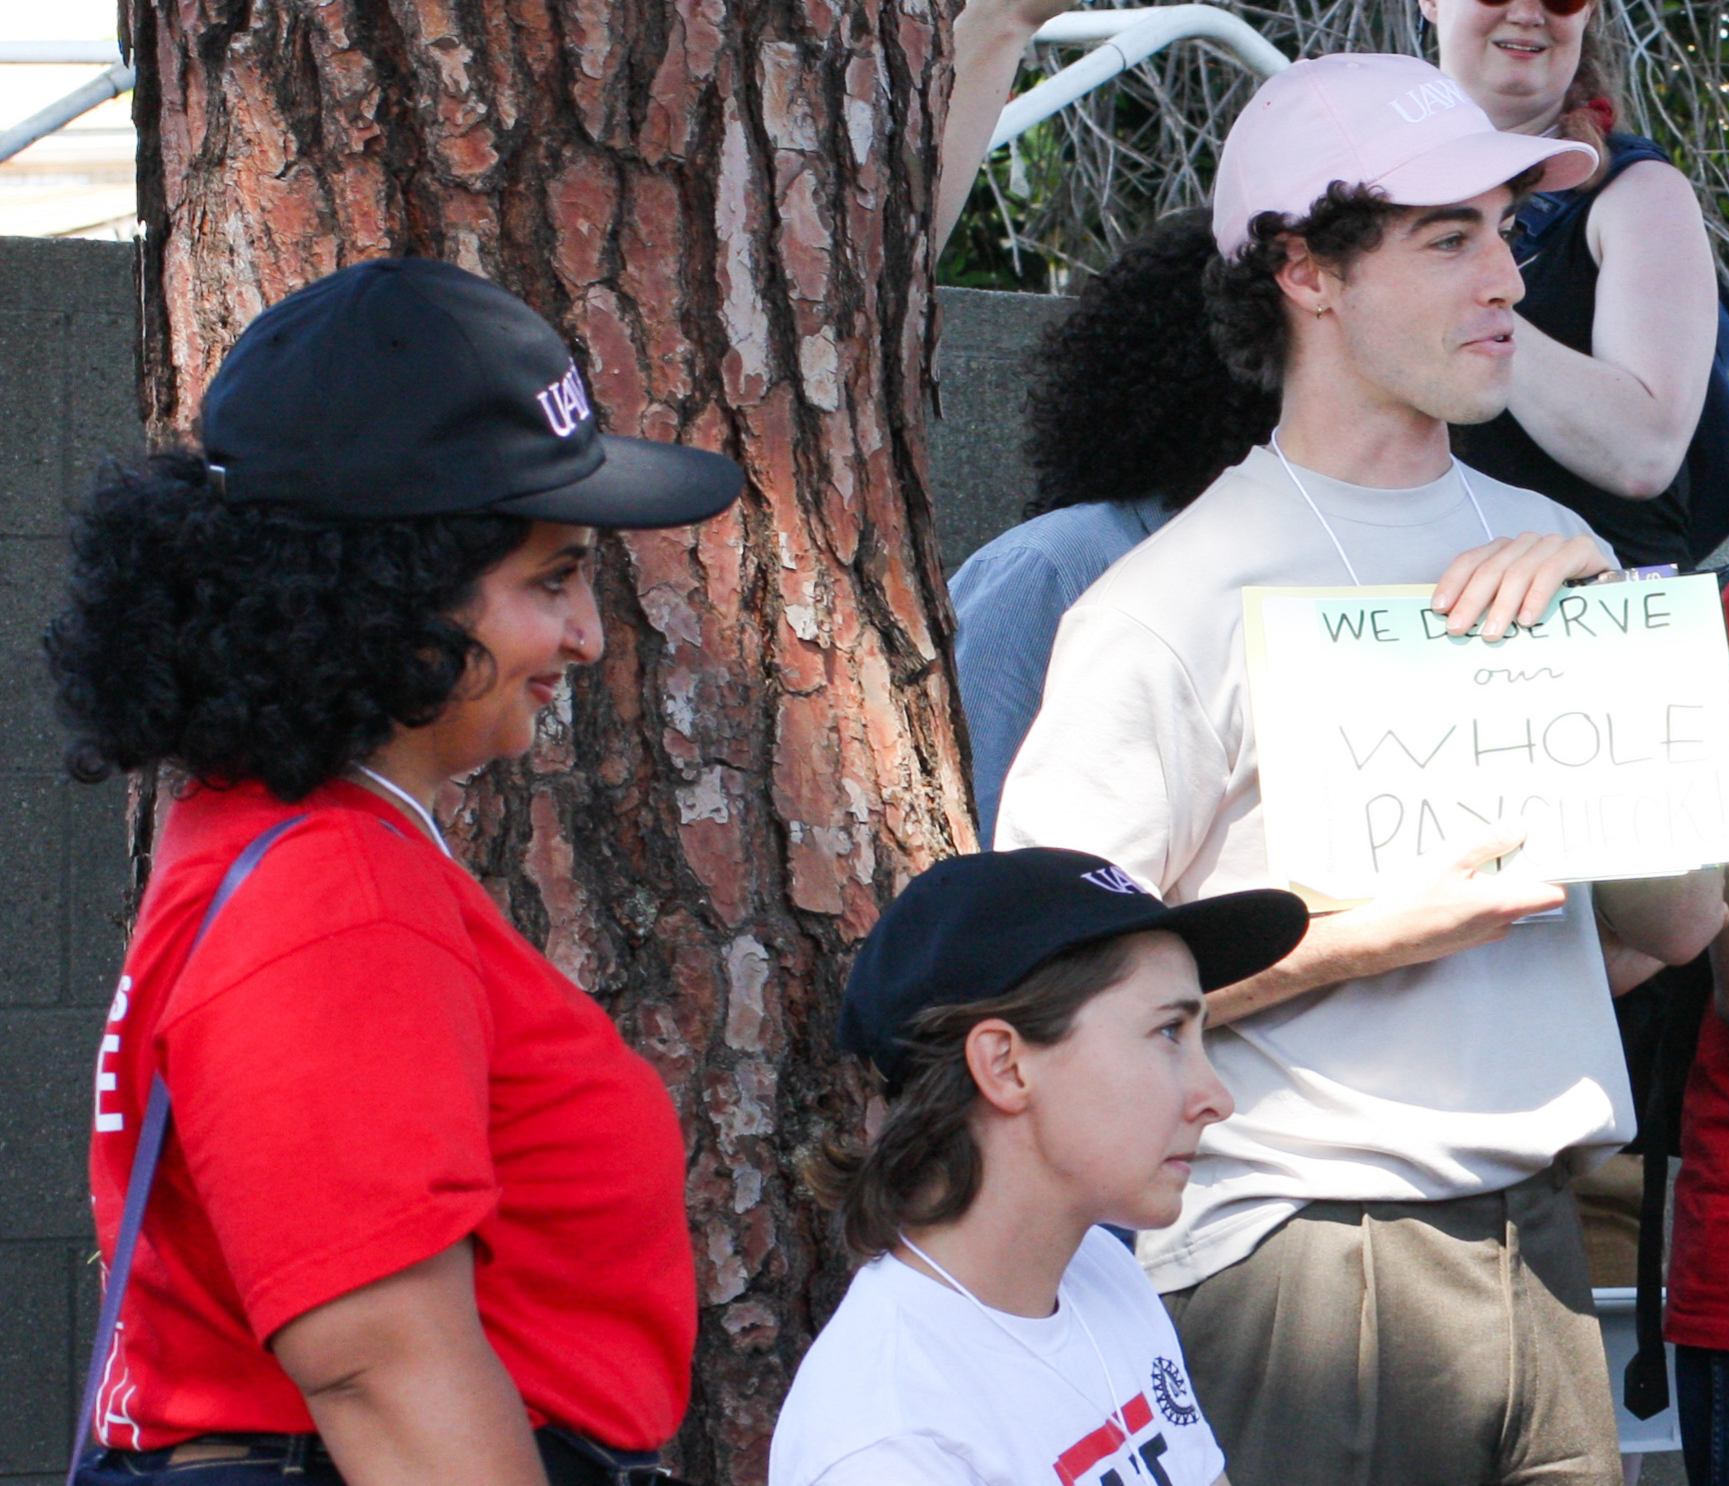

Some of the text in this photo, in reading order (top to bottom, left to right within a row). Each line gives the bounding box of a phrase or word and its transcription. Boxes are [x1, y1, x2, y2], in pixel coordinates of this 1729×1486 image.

[1322, 608, 1400, 642] WE
[1473, 665, 1565, 687] our
[1338, 703, 1708, 771] WHOLE
